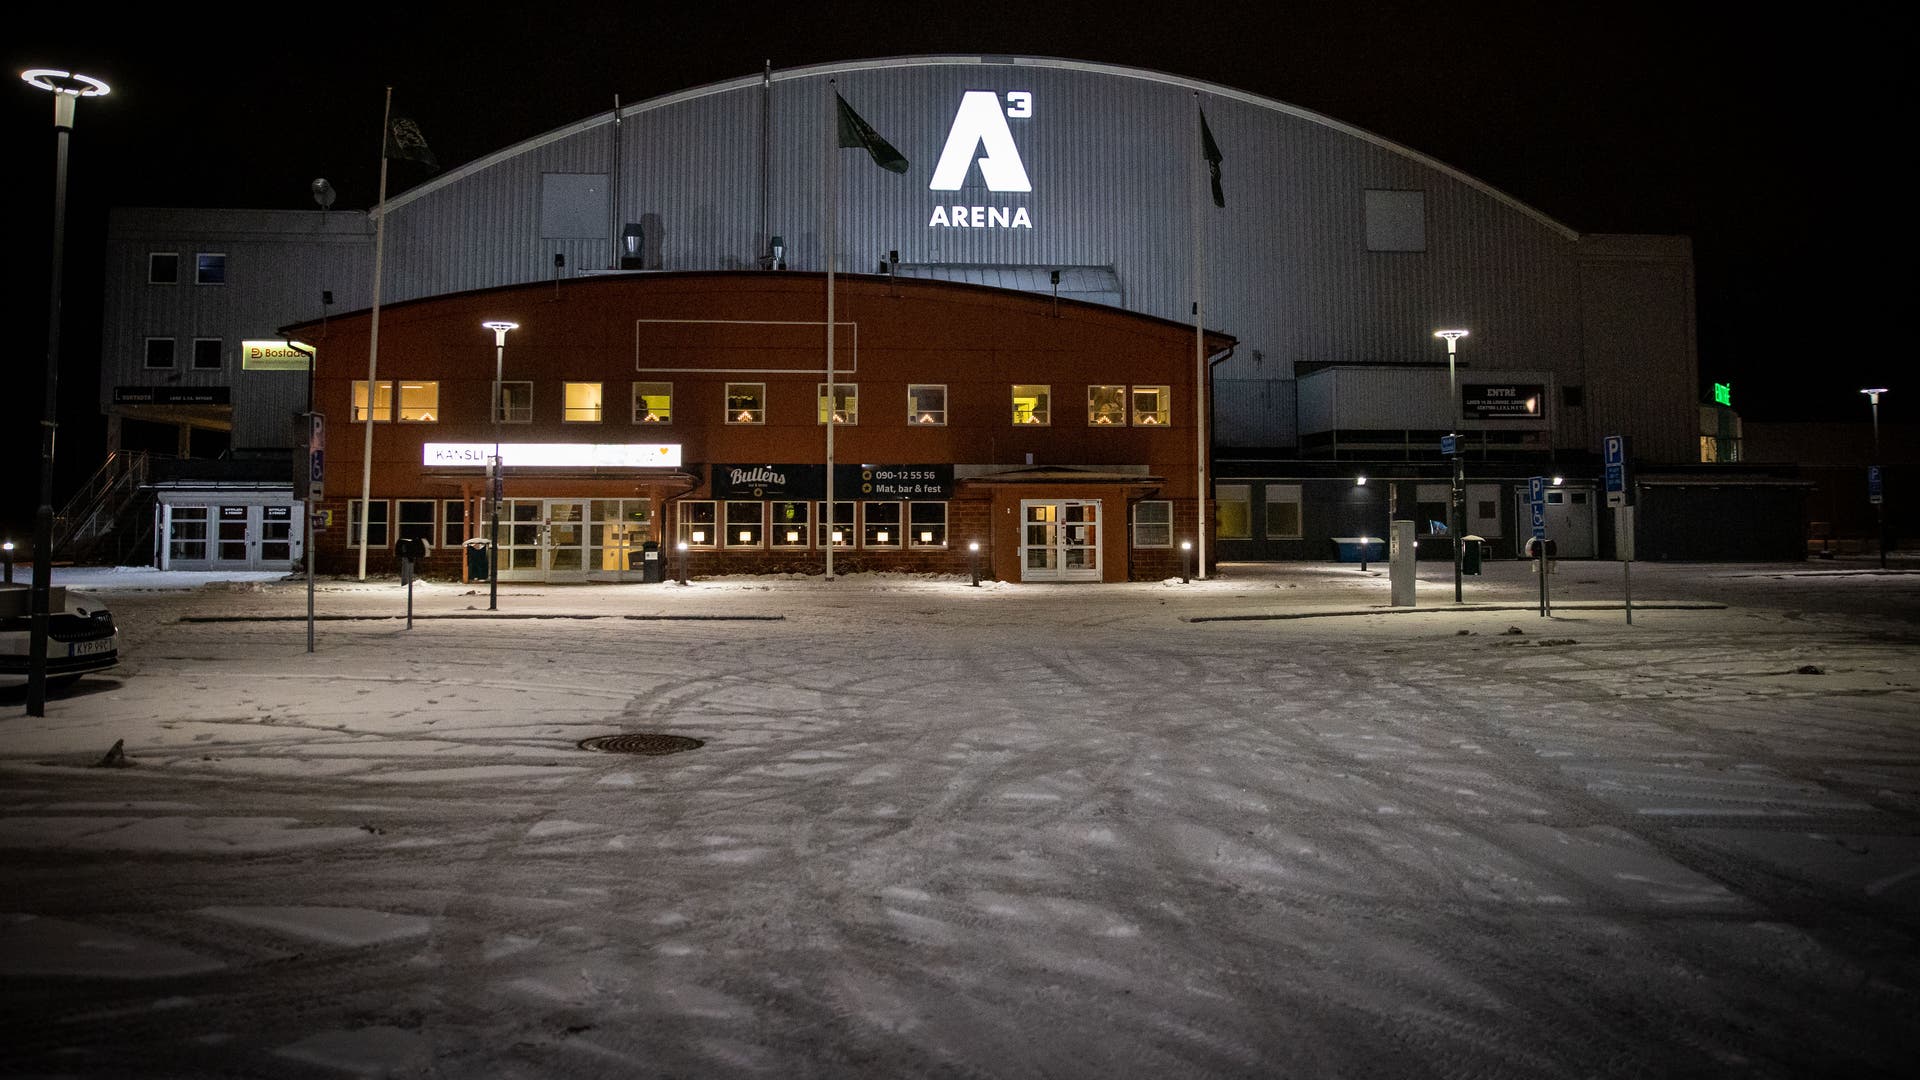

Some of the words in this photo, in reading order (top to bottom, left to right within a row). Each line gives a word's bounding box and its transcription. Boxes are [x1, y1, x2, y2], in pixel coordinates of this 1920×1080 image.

[929, 205, 1032, 228] ARENA
[1487, 387, 1516, 397] ENTRÉ
[436, 449, 483, 461] KANSLI
[1608, 439, 1619, 462] P
[730, 467, 787, 485] Bullens
[875, 471, 909, 480] 090-12
[910, 471, 922, 480] 55
[923, 471, 936, 480] 56
[876, 484, 896, 494] Mat,
[898, 484, 913, 493] bar
[914, 484, 922, 493] &
[924, 484, 942, 493] fest
[1532, 479, 1541, 500] P
